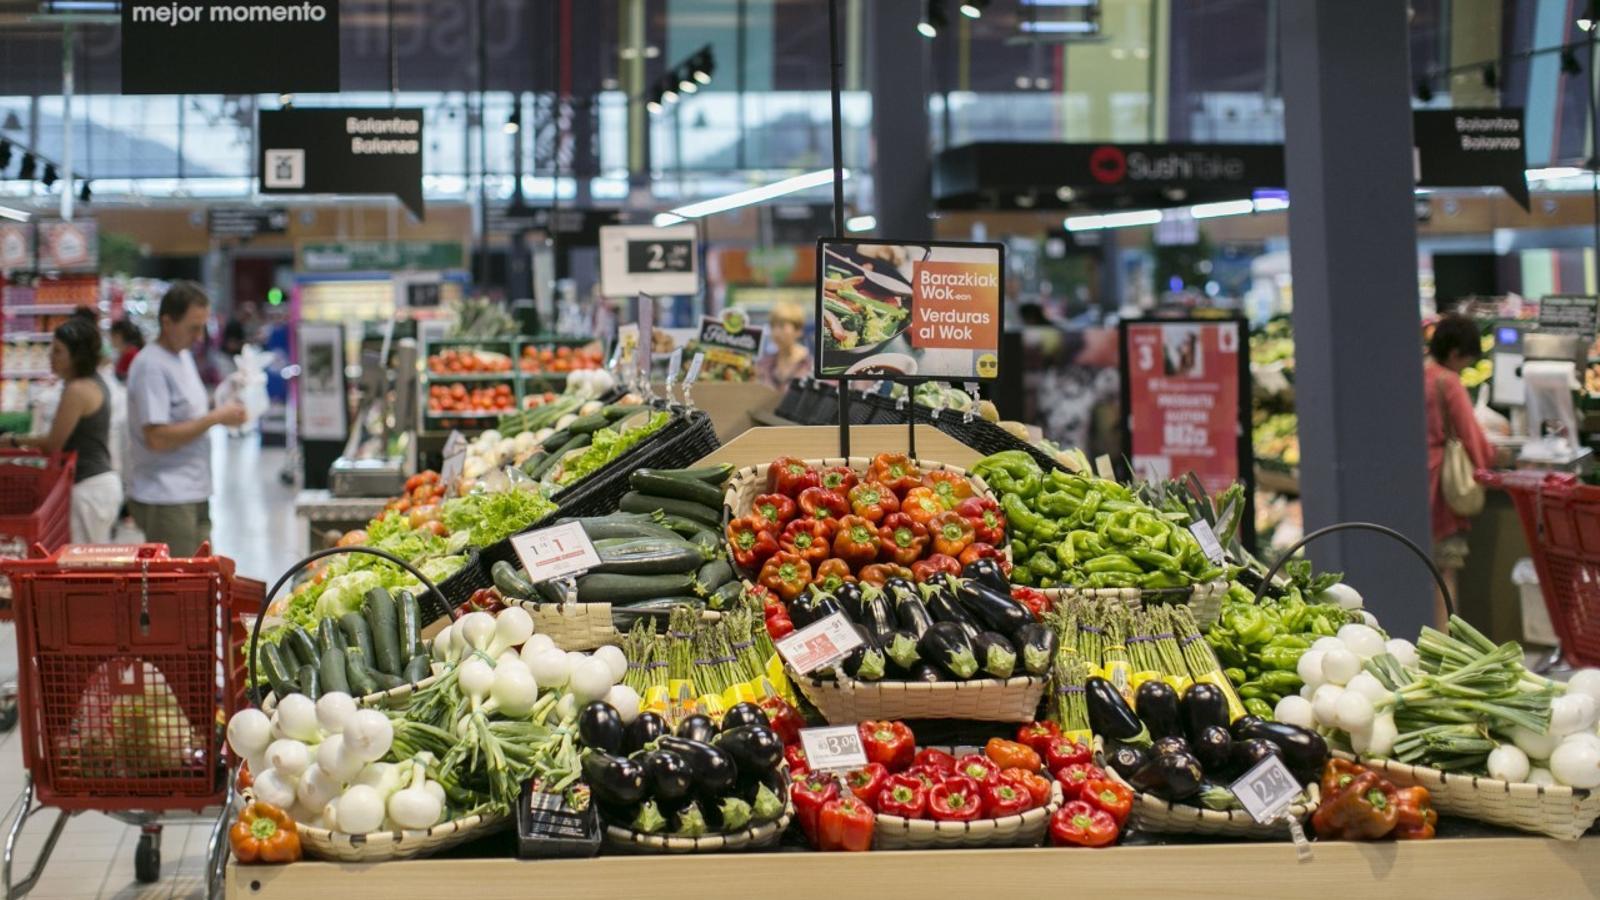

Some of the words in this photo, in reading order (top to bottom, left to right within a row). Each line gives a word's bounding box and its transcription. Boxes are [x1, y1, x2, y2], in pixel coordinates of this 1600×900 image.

[132, 2, 203, 26] mejor
[210, 2, 326, 22] momento
[920, 270, 998, 287] Barazkiak
[920, 308, 990, 324] Verduras
[919, 325, 935, 339] al
[939, 325, 972, 340] Wok
